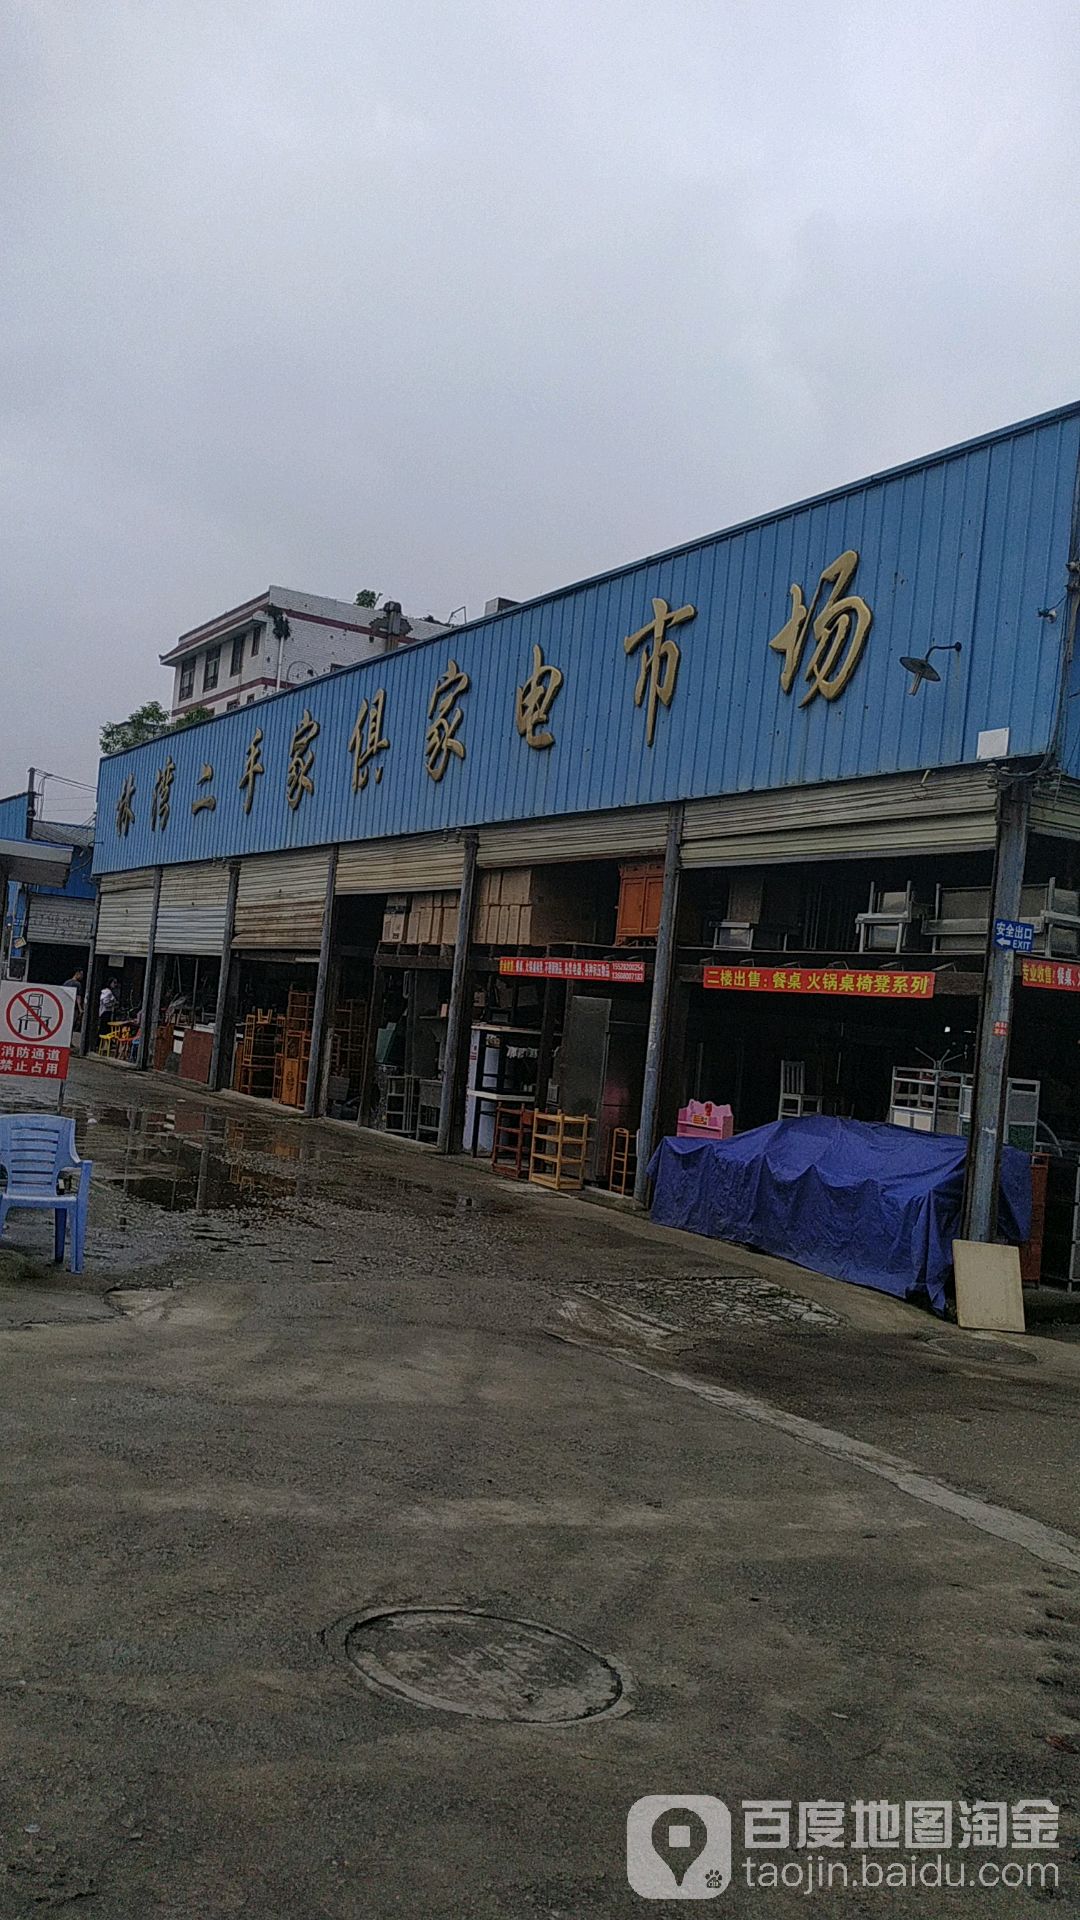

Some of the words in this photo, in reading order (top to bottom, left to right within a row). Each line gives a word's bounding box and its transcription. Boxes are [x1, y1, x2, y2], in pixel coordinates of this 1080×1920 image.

[996, 922, 1032, 940] 安全出口
[1012, 940, 1031, 950] EXIT
[806, 972, 929, 995] 火锅桌椅凳系列
[1, 1045, 61, 1061] 消防通道
[0, 1058, 58, 1075] 禁止占用
